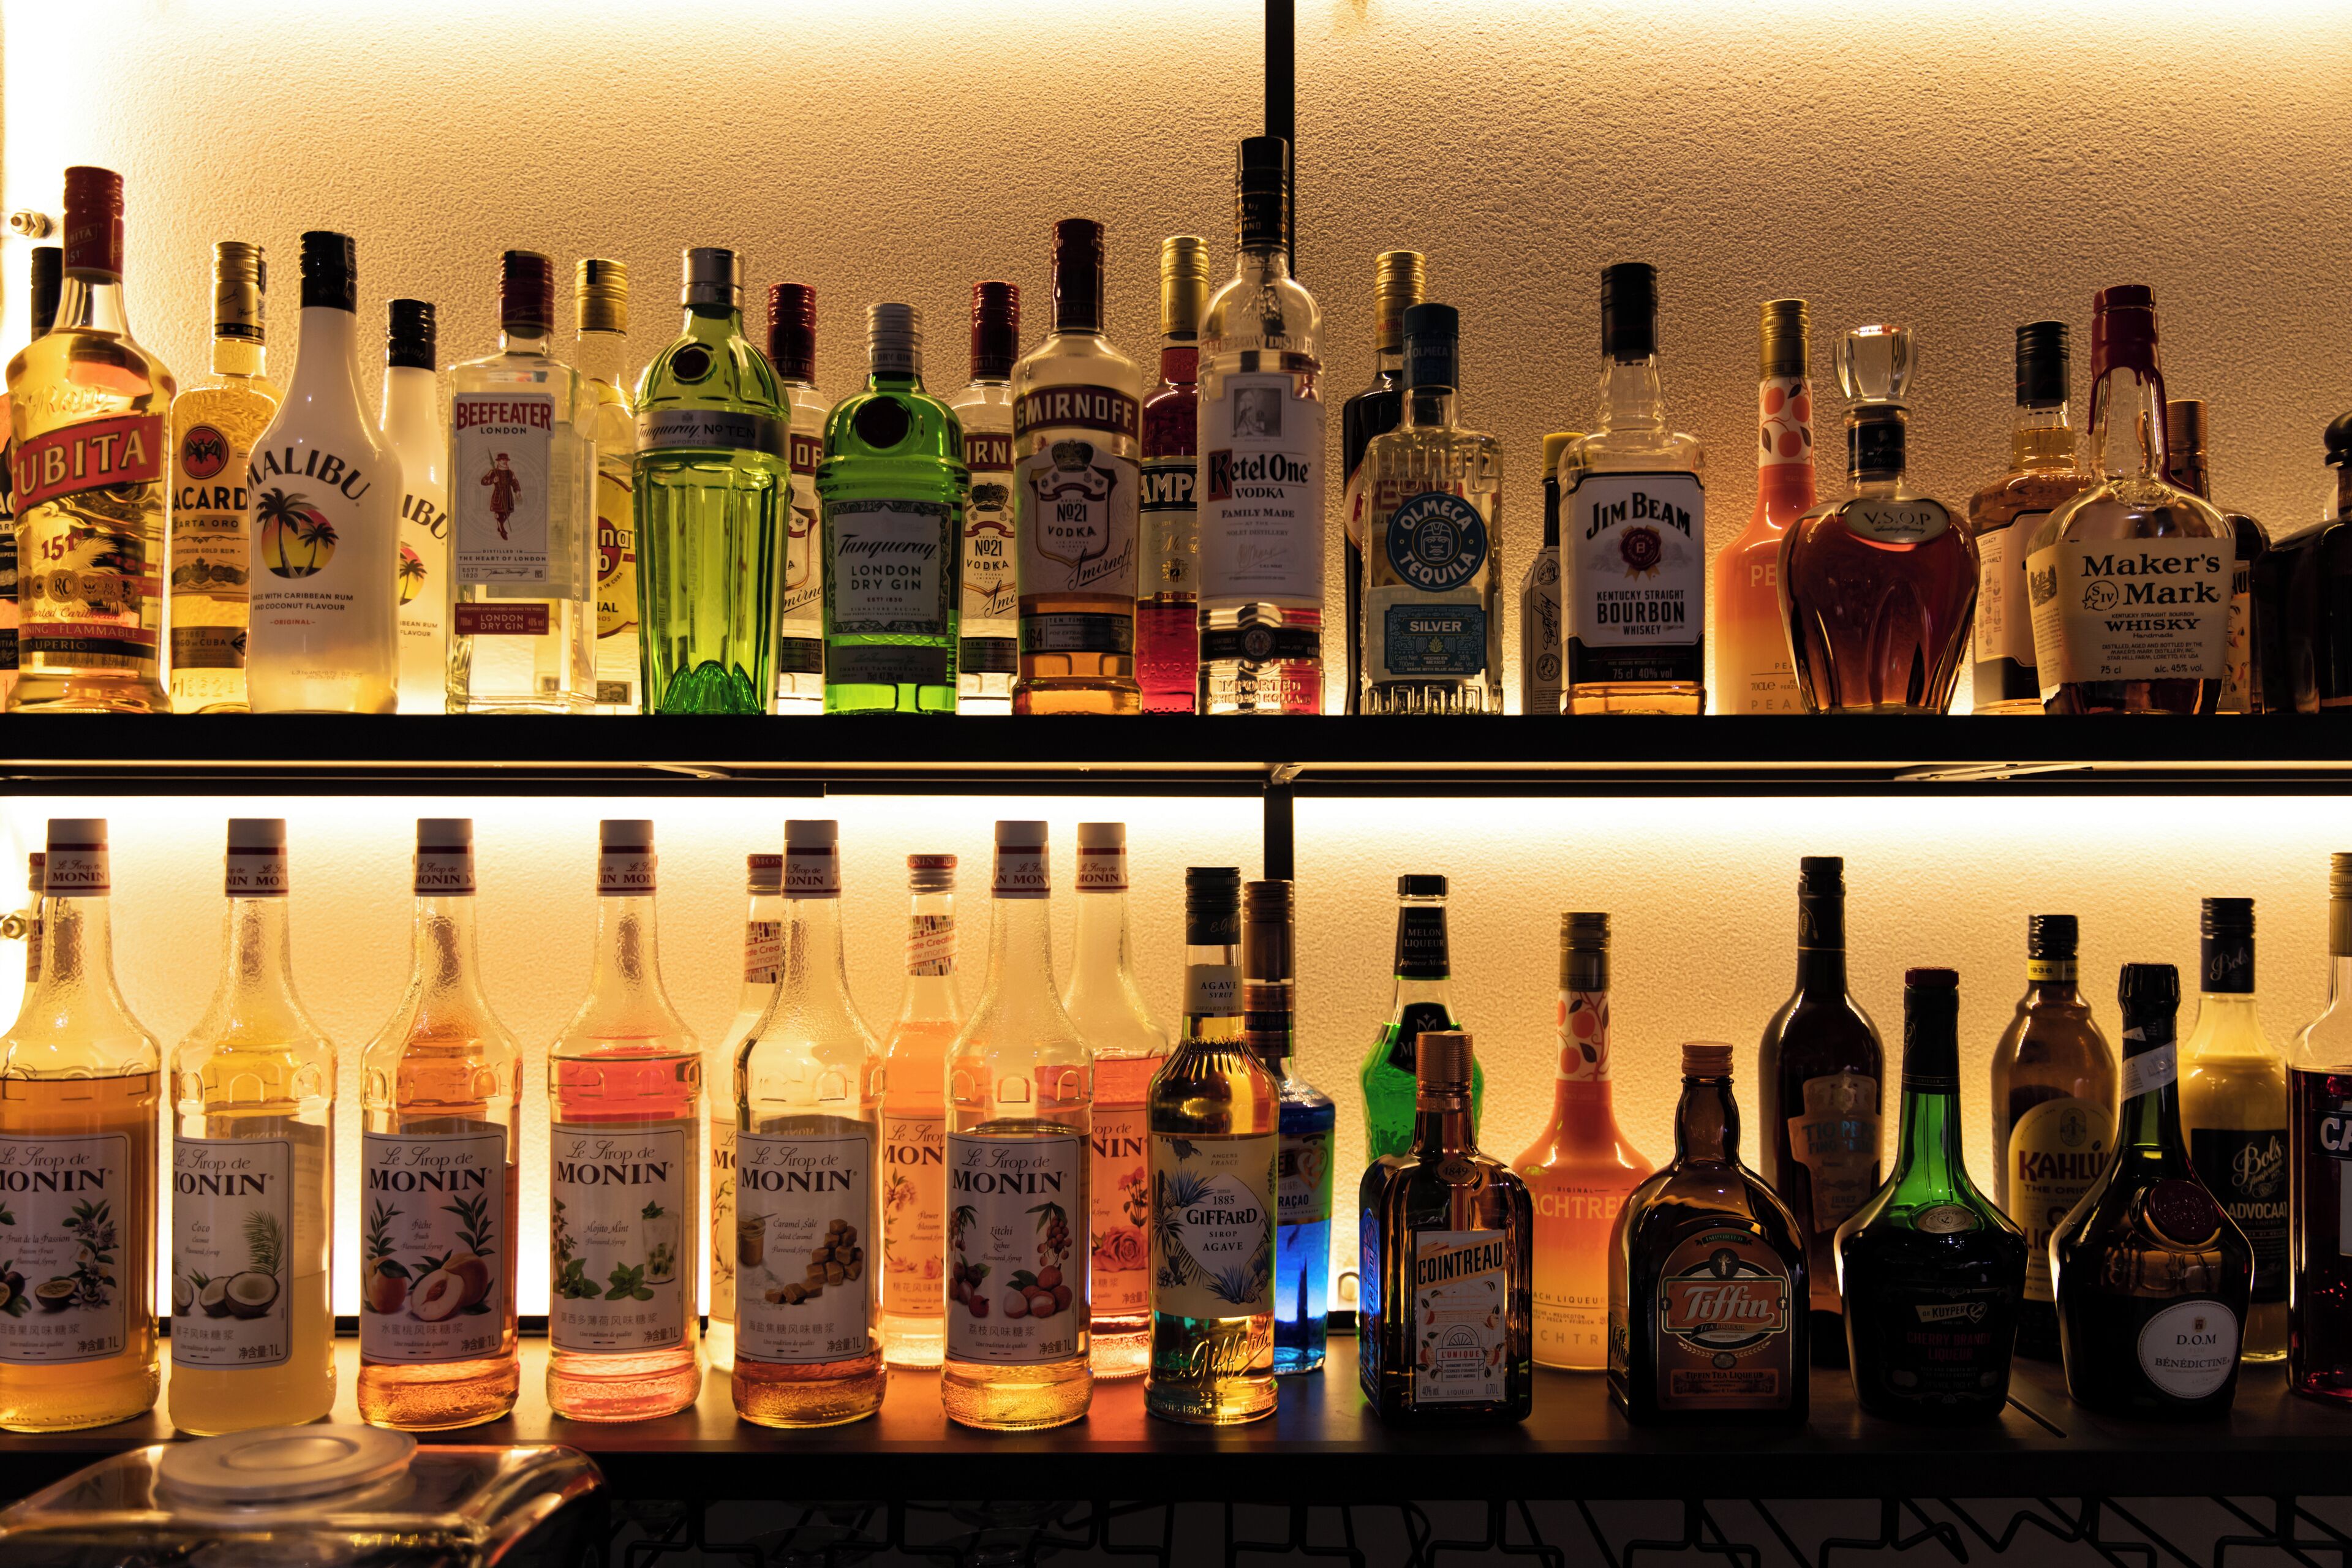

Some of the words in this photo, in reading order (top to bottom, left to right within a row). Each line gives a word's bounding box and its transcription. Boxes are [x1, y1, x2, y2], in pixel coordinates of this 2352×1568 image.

[1413, 346, 1448, 357] OLMECA
[456, 402, 552, 431] BEEFEATER
[1017, 393, 1133, 431] SMIRNOFF
[637, 424, 700, 441] Tanqueray
[15, 429, 148, 496] UBITA
[1209, 453, 1265, 494] Ketel
[1270, 453, 1309, 483] One
[1235, 488, 1284, 499] VODKA
[1222, 510, 1261, 518] FAMILY
[1263, 509, 1294, 518] MADE
[1400, 500, 1472, 532] OLMECA
[1586, 500, 1628, 540] JIM
[1631, 492, 1693, 540] BEAM
[211, 519, 238, 528] ORO
[1048, 526, 1097, 537] VODKA
[838, 534, 937, 560] Tanqueray
[852, 565, 921, 576] LONDON
[967, 559, 1009, 571] VODKA
[1399, 551, 1476, 584] TEQUILA
[2081, 554, 2220, 577] Maker's
[852, 579, 883, 590] DRY
[891, 579, 921, 590] GIN
[1597, 591, 1642, 601] KENTUCKY
[1645, 590, 1684, 600] STRAIGHT
[2123, 582, 2219, 606] Mark
[1597, 601, 1684, 624] BOURBON
[59, 626, 138, 638] FLAMMABLE
[1410, 621, 1461, 632] SILVER
[1623, 625, 1661, 635] WHISKEY
[2105, 619, 2201, 631] WHISKY
[1613, 668, 1623, 679] 75
[1626, 668, 1633, 679] cl
[1639, 668, 1657, 679] 40%
[1660, 668, 1672, 678] vol
[53, 873, 105, 882] MONIN
[2210, 946, 2250, 982] Bols
[1200, 981, 1238, 990] AGAVE
[887, 1124, 907, 1141] Le
[1116, 1122, 1131, 1134] de
[20, 1146, 64, 1172] Sirop
[70, 1153, 90, 1165] de
[379, 1146, 402, 1165] Le
[405, 1146, 450, 1171] Sirop
[455, 1152, 473, 1164] de
[566, 1140, 586, 1159] Le
[589, 1140, 632, 1164] Sirop
[638, 1147, 655, 1158] de
[750, 1147, 770, 1166] Le
[773, 1147, 816, 1172] Sirop
[821, 1153, 839, 1166] de
[188, 1148, 226, 1174] Sirop
[231, 1157, 250, 1169] de
[961, 1148, 981, 1167] Le
[986, 1148, 1028, 1173] Sirop
[1033, 1156, 1049, 1168] de
[2019, 1140, 2111, 1182] KAHLÚ
[2232, 1135, 2284, 1187] Bols
[557, 1161, 668, 1185] MONIN
[1443, 1167, 1469, 1176] 1849
[369, 1167, 488, 1192] MONIN
[741, 1167, 851, 1193] MONIN
[952, 1169, 1063, 1195] MONIN
[2024, 1185, 2051, 1194] THE
[1213, 1196, 1235, 1205] 1885
[773, 1217, 800, 1228] Caramel
[801, 1216, 818, 1230] Salé
[1186, 1208, 1257, 1225] GIFFARD
[192, 1221, 210, 1232] Coco
[584, 1220, 608, 1236] Mojito
[989, 1225, 1013, 1241] Litchi
[993, 1242, 1010, 1251] Lychee
[1203, 1242, 1243, 1251] AGAVE
[1418, 1242, 1502, 1285] COINTREAU
[1683, 1285, 1775, 1322] Tiffin
[1932, 1306, 1966, 1319] KUYPER
[381, 1322, 464, 1336] 水蜜桃风味糖浆
[969, 1323, 1036, 1338] 荔枝风味糖浆
[1907, 1332, 1950, 1346] CHERRY
[1954, 1332, 1991, 1346] BRANDY
[2176, 1334, 2217, 1345] D.O.M
[1441, 1350, 1480, 1359] L'UNIQUE
[1928, 1348, 1973, 1362] LIQUEUR
[2155, 1357, 2227, 1368] BÉNÉDICTINE
